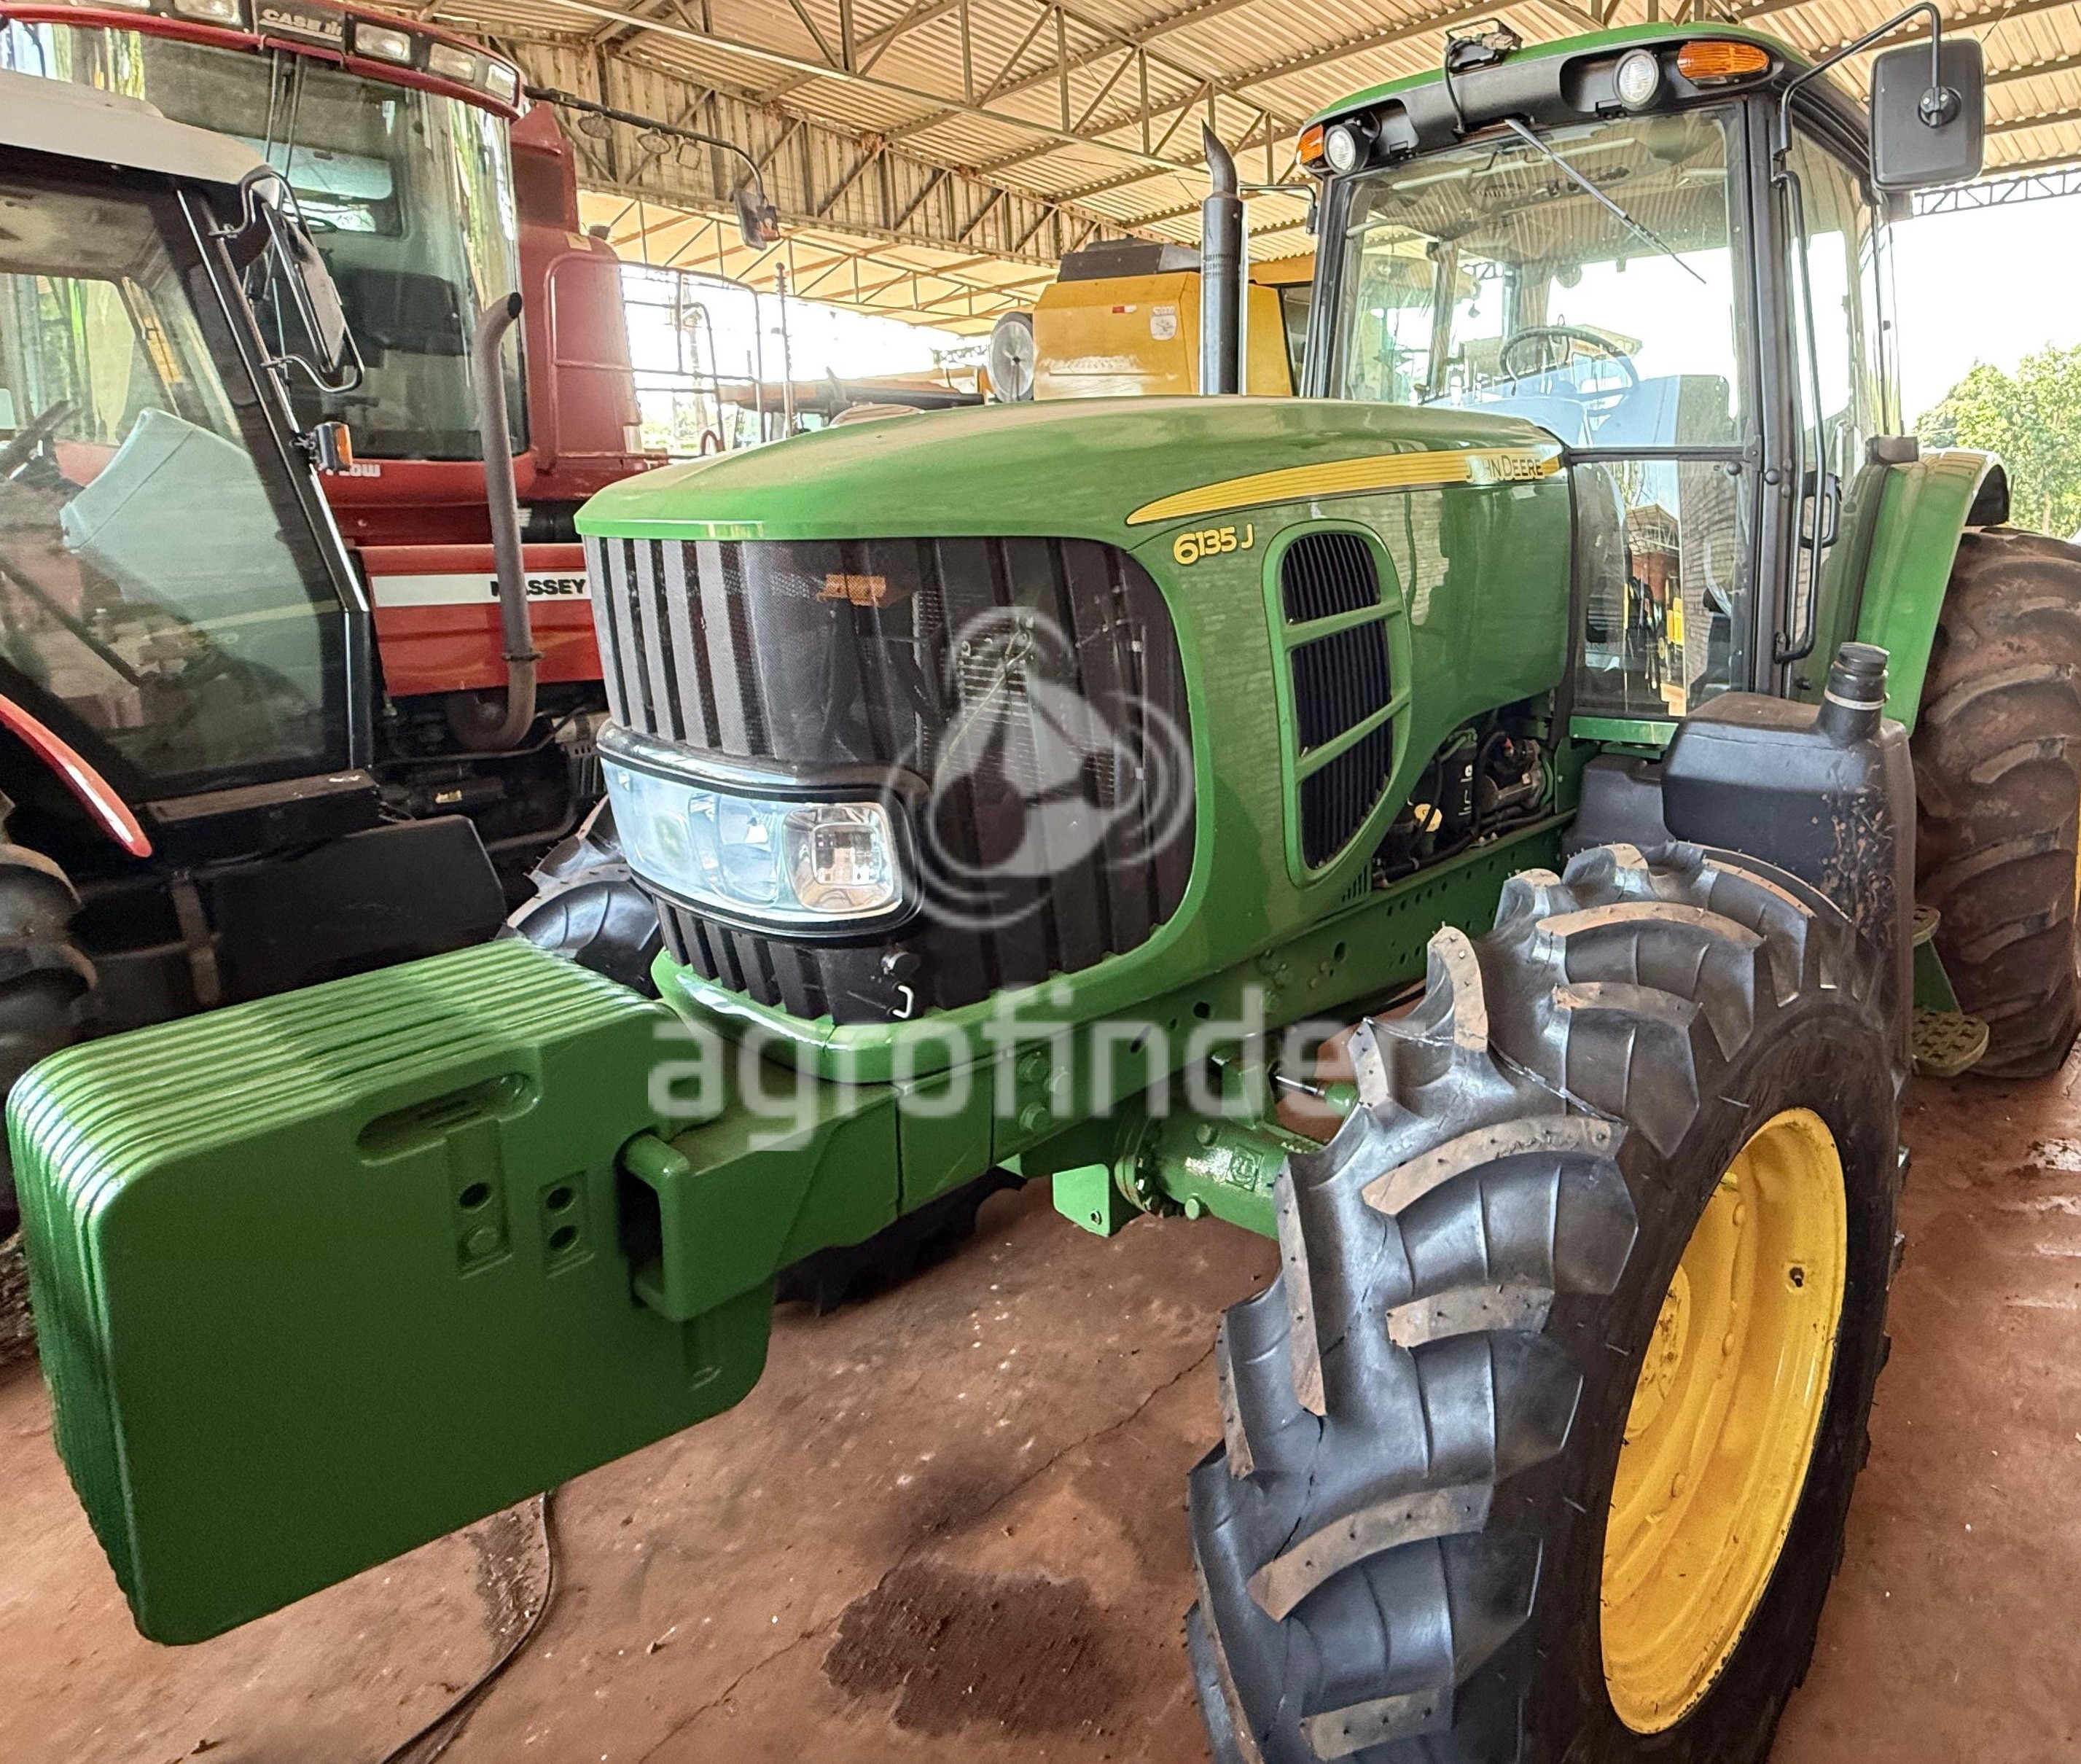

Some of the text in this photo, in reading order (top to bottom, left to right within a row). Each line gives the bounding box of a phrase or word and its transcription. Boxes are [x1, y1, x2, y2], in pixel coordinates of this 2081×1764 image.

[262, 8, 321, 32] CASE
[1174, 523, 1254, 564] 6135 J
[490, 579, 586, 596] SSEY
